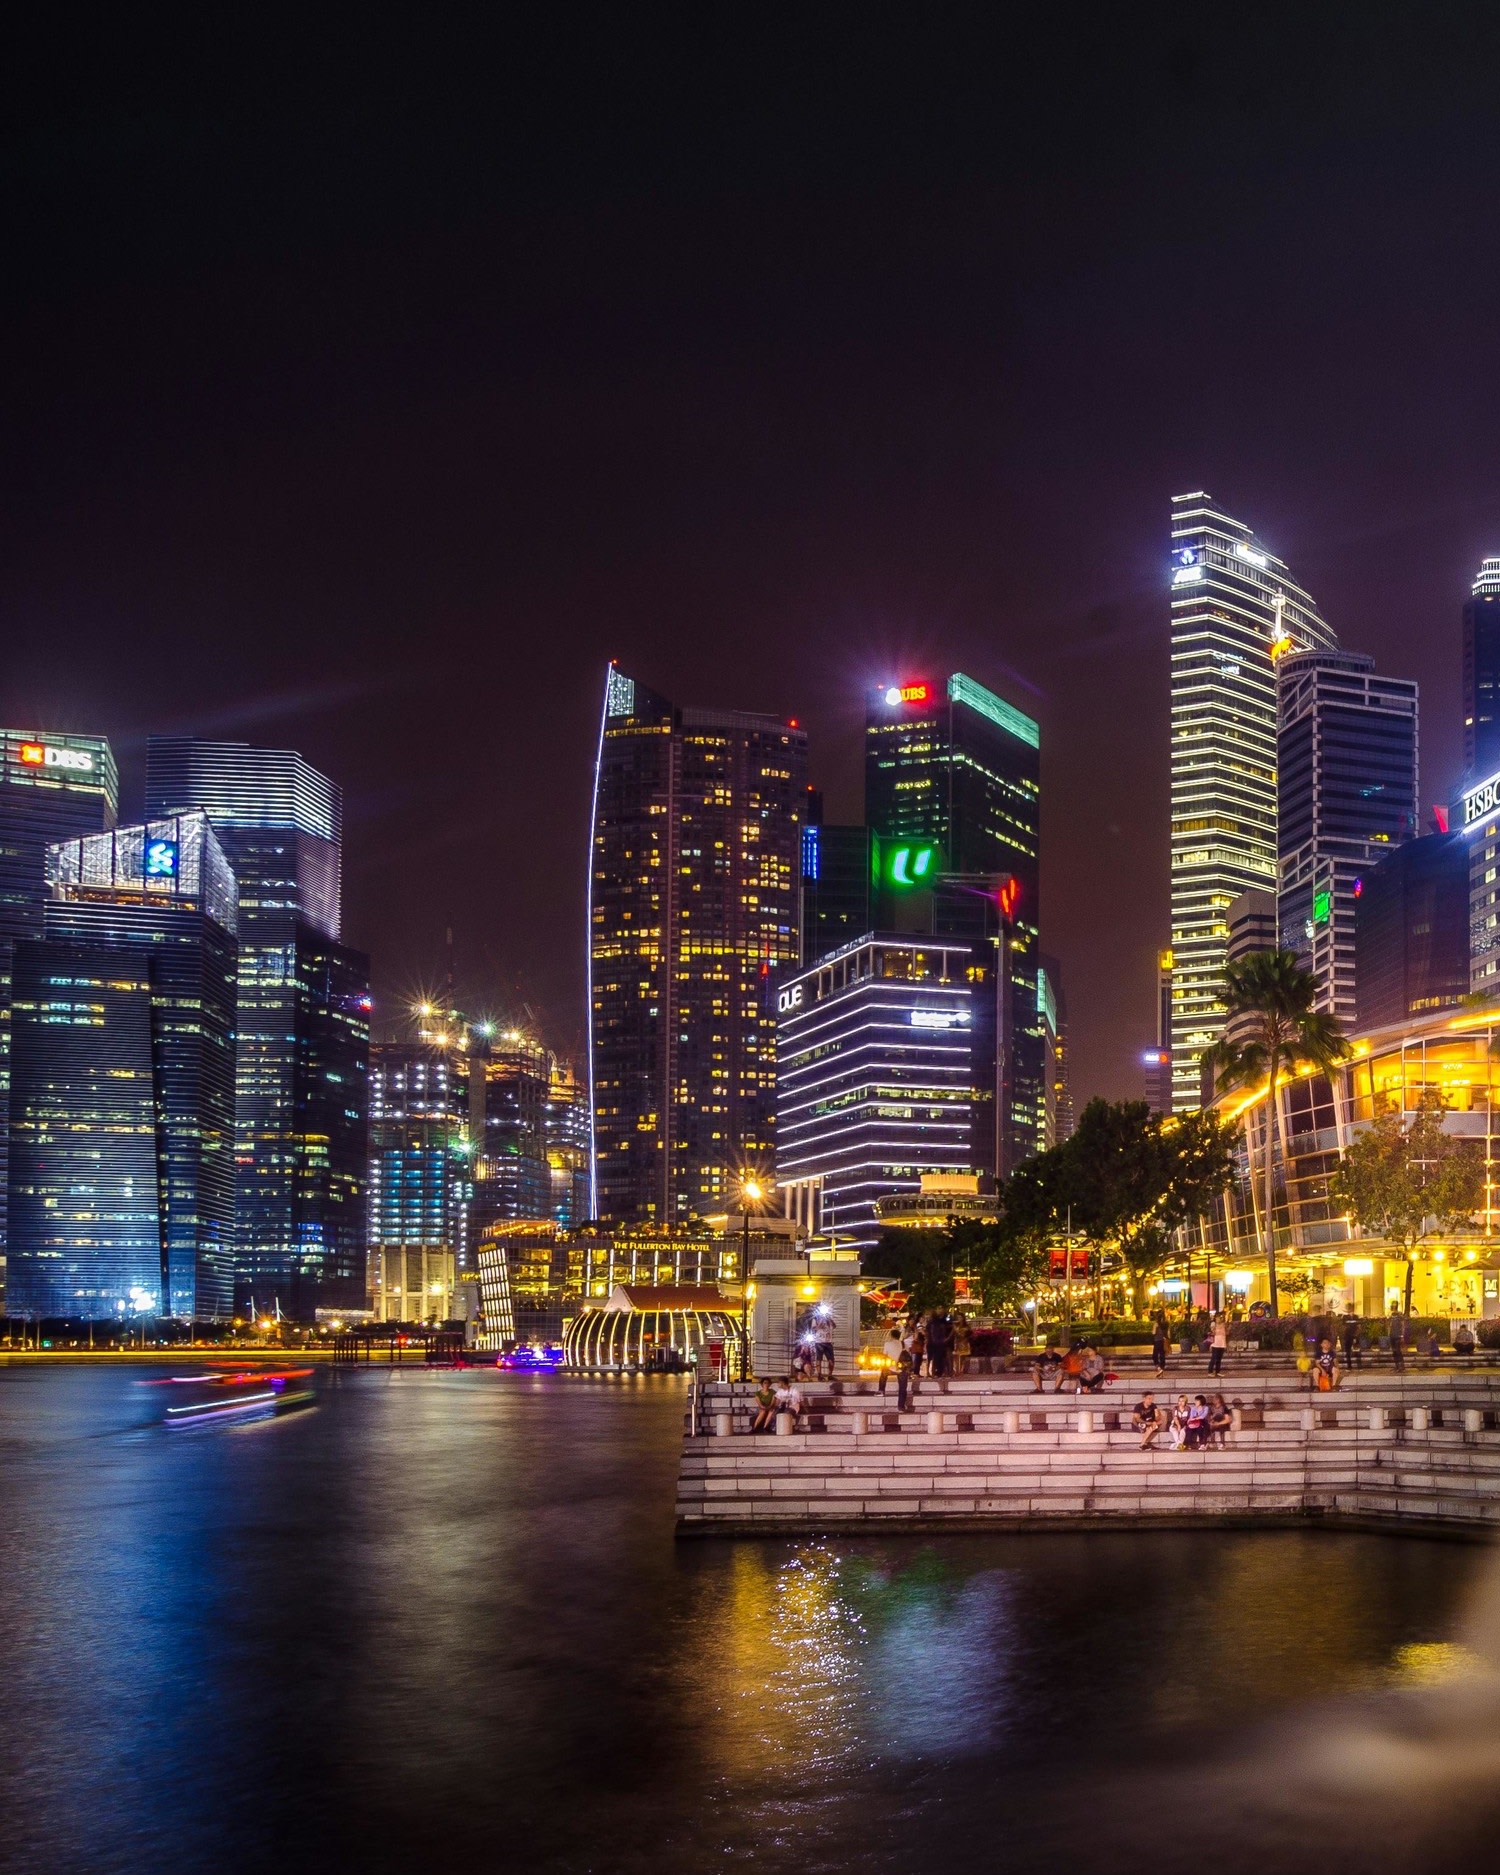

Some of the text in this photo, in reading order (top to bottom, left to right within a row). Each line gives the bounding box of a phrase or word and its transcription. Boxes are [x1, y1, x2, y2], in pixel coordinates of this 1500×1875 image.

[901, 686, 926, 701] UBS
[44, 747, 93, 770] DBS
[778, 984, 803, 1013] OUE
[613, 1241, 628, 1250] THE
[629, 1241, 671, 1250] FULLERTON
[672, 1243, 686, 1251] BAY
